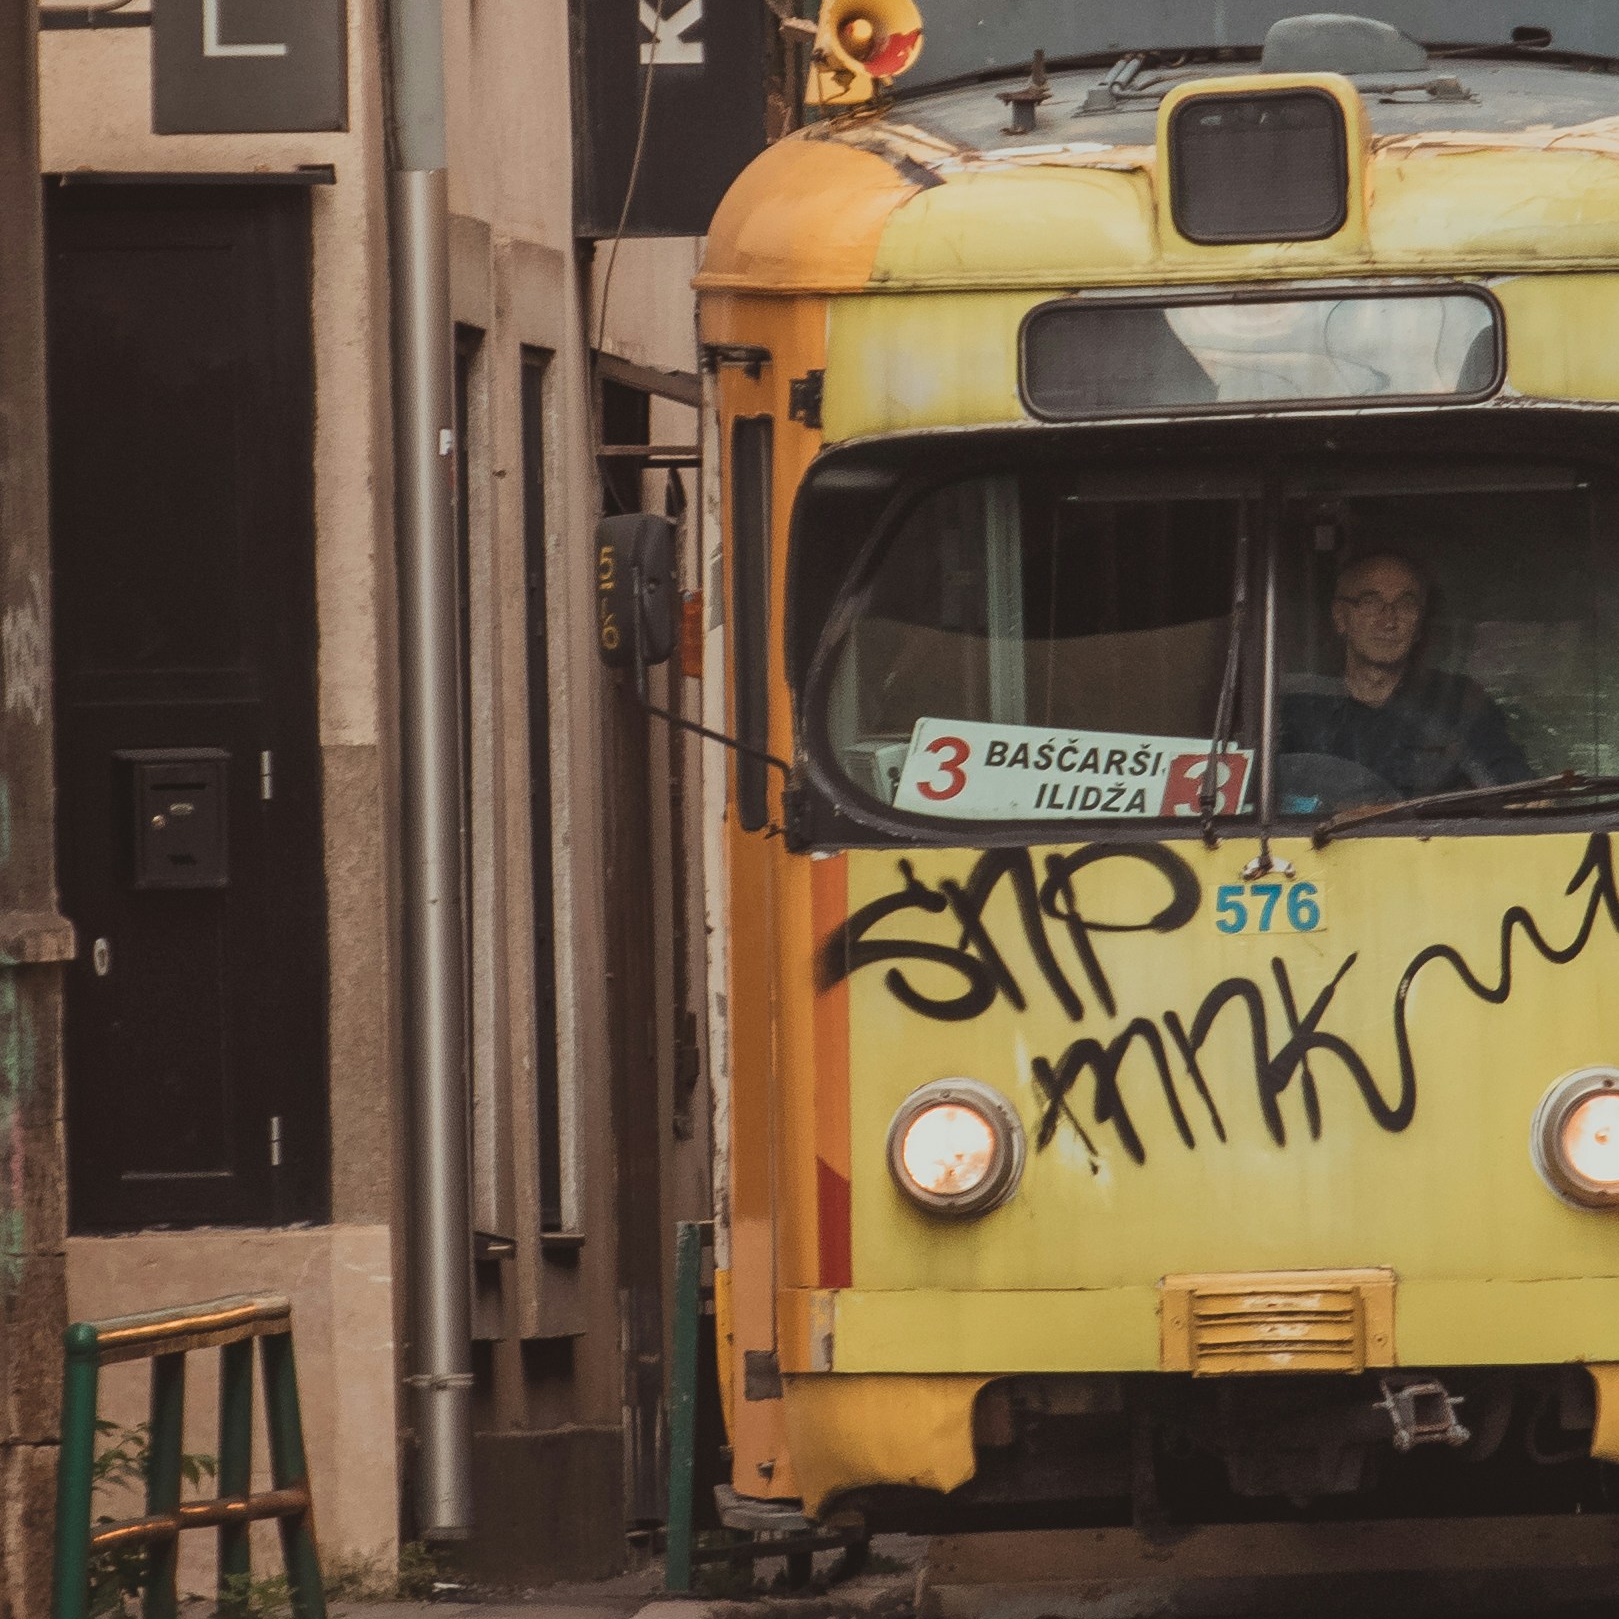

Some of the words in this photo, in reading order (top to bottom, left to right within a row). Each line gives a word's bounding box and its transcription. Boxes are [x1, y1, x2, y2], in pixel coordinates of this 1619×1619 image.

[916, 736, 971, 800] 3
[1034, 782, 1146, 813] ILIDŽA
[1216, 882, 1320, 934] 576
